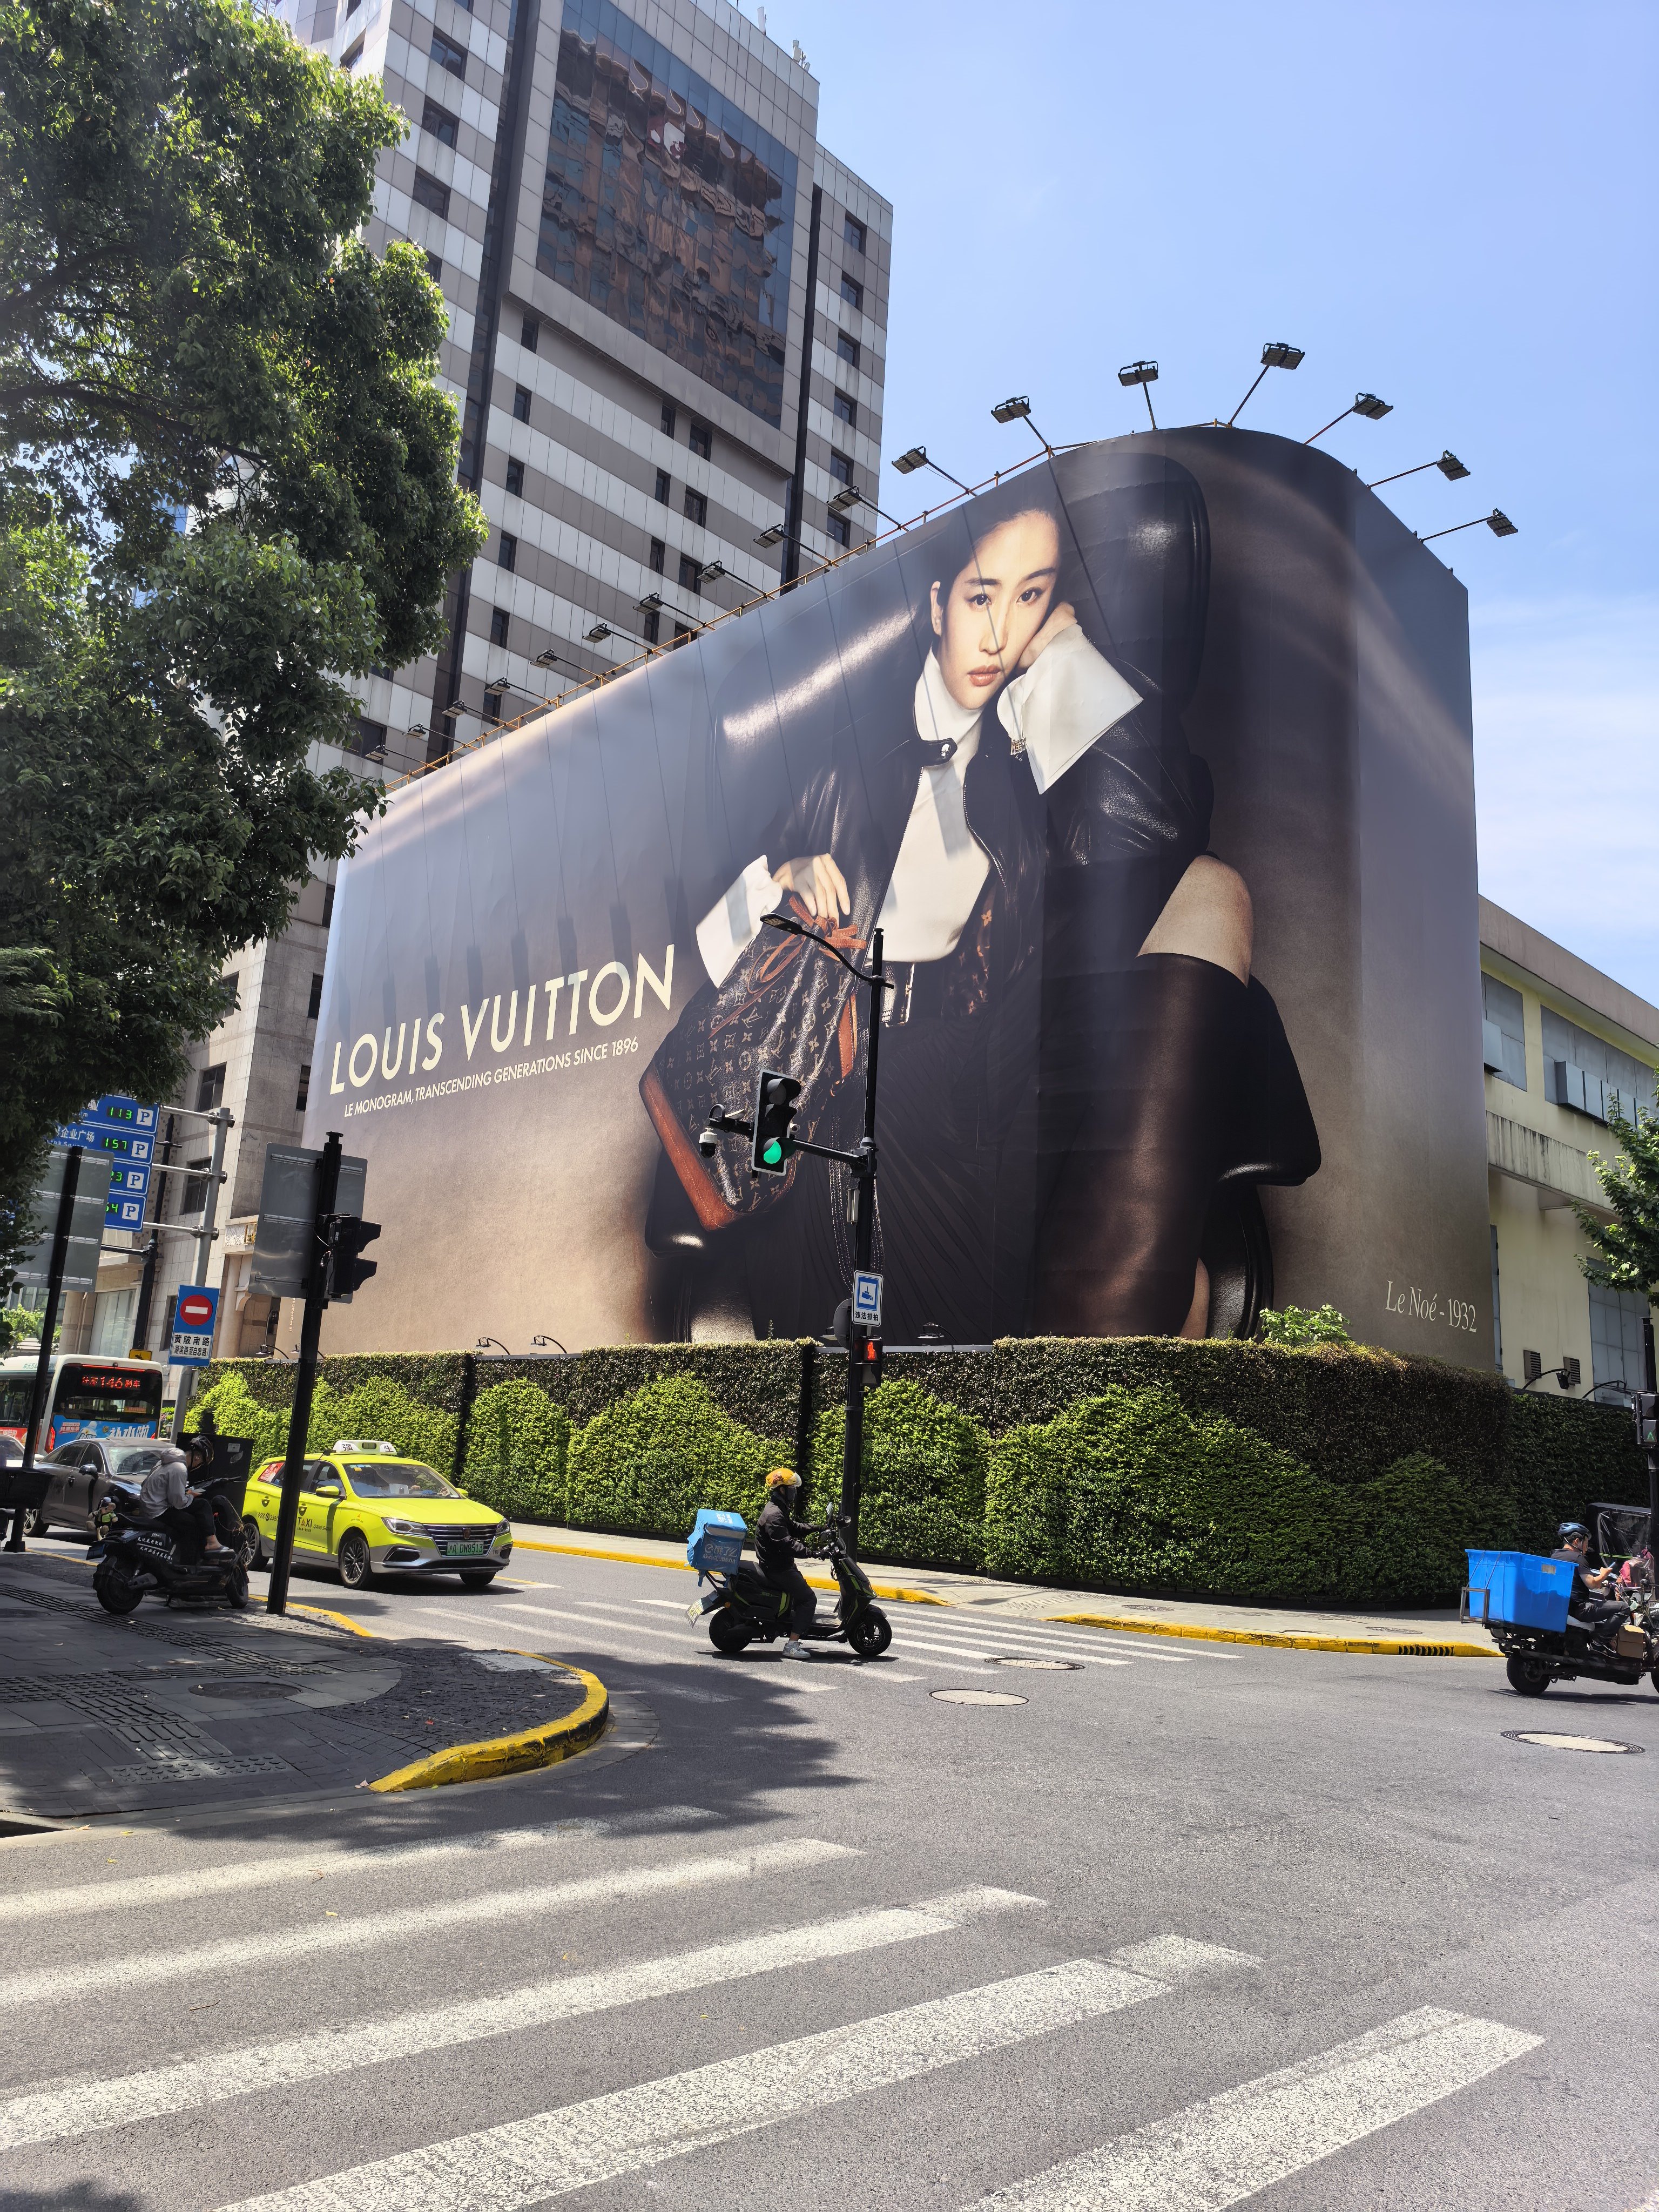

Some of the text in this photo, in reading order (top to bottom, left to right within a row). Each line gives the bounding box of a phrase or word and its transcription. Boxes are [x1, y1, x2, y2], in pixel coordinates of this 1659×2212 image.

[330, 943, 675, 1095] LOUIS VUITTON
[344, 1036, 638, 1117] LE MONOGRAM, TRANSCENDING GENERATIONS SINCE 1896
[109, 1107, 132, 1119] 113
[105, 1138, 127, 1150] 157
[1385, 1280, 1405, 1313] Le
[1408, 1286, 1438, 1321] Noé
[1447, 1298, 1477, 1333] 1932
[855, 1311, 879, 1321] 违法抓拍
[174, 1334, 210, 1346] 黄陂南路
[100, 1377, 123, 1388] 146
